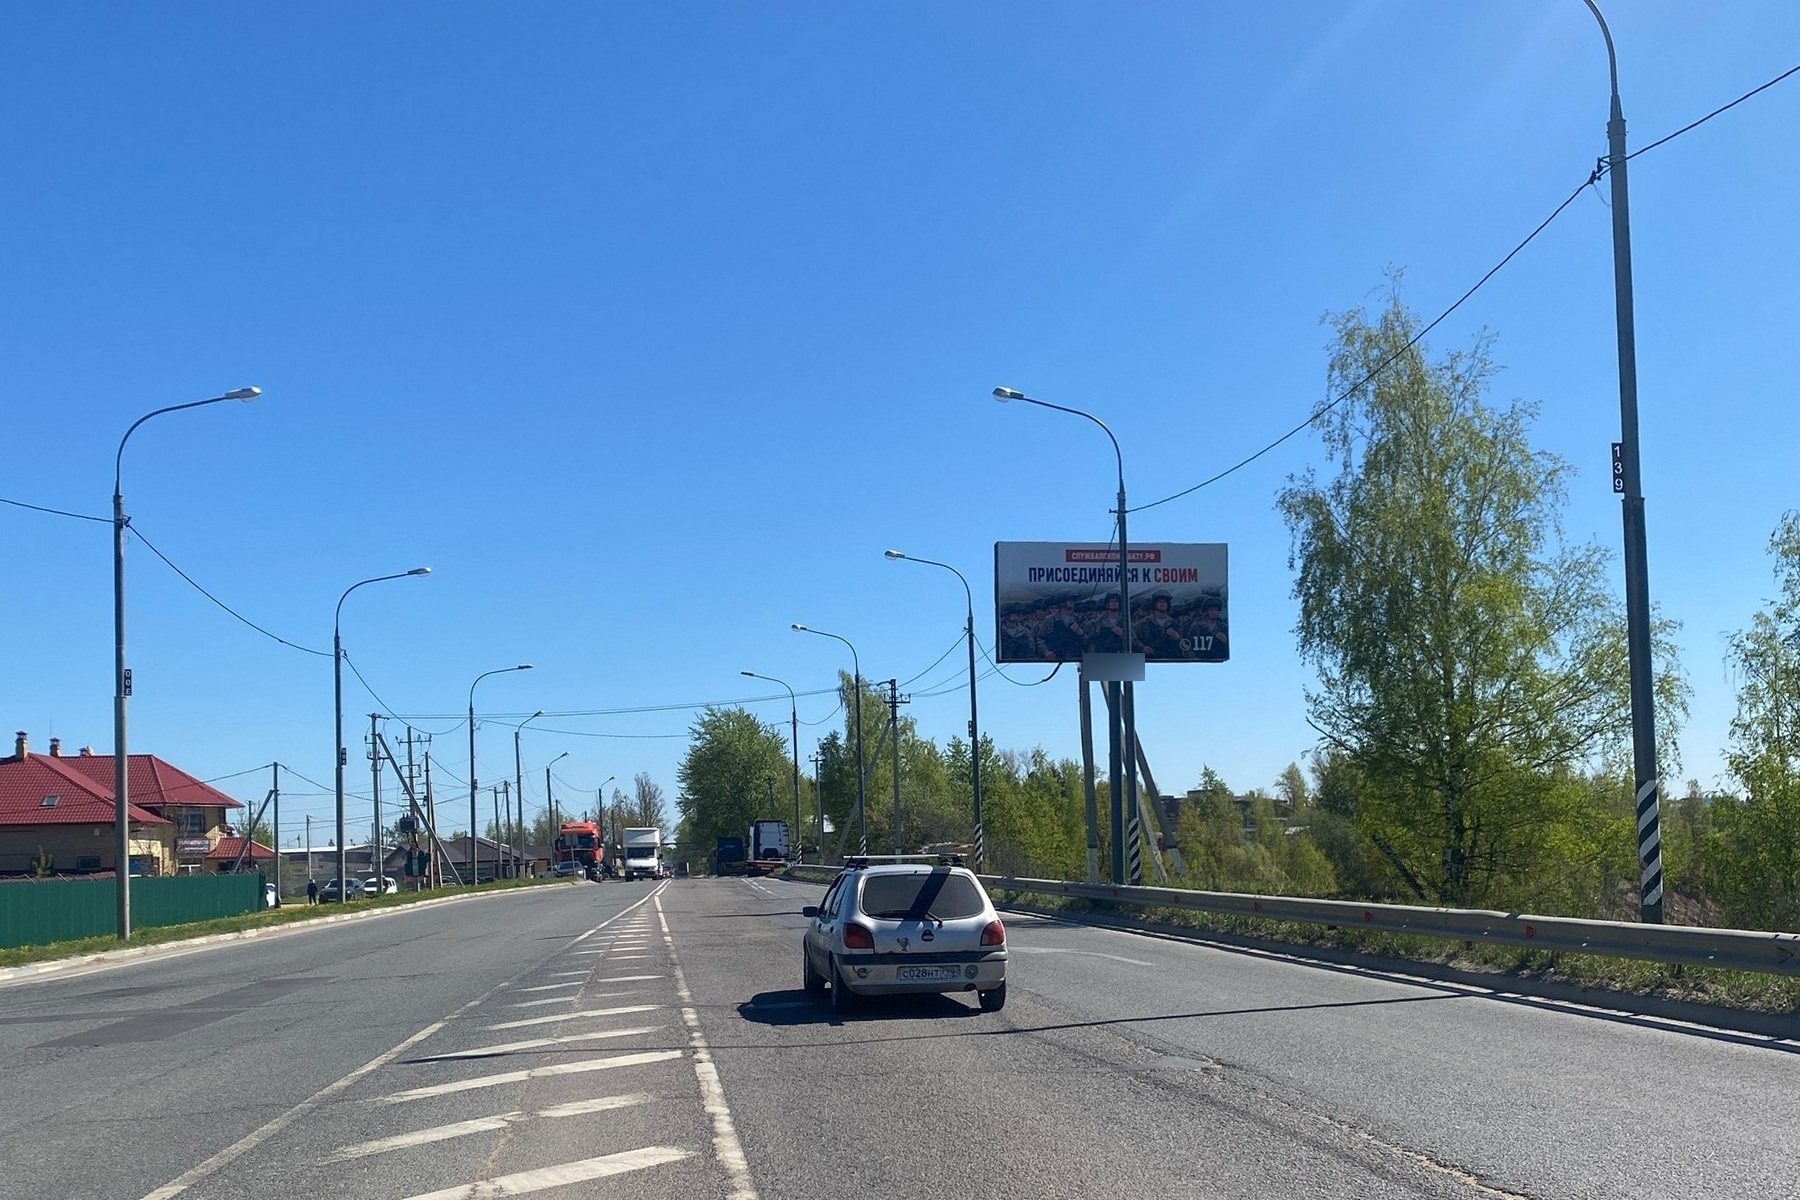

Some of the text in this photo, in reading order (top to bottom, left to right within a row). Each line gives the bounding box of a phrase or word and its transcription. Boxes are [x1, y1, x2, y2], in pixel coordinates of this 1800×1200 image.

[1613, 445, 1624, 491] 139
[1143, 568, 1151, 582] К
[1154, 568, 1198, 583] СВОИМ
[1193, 636, 1213, 651] 117
